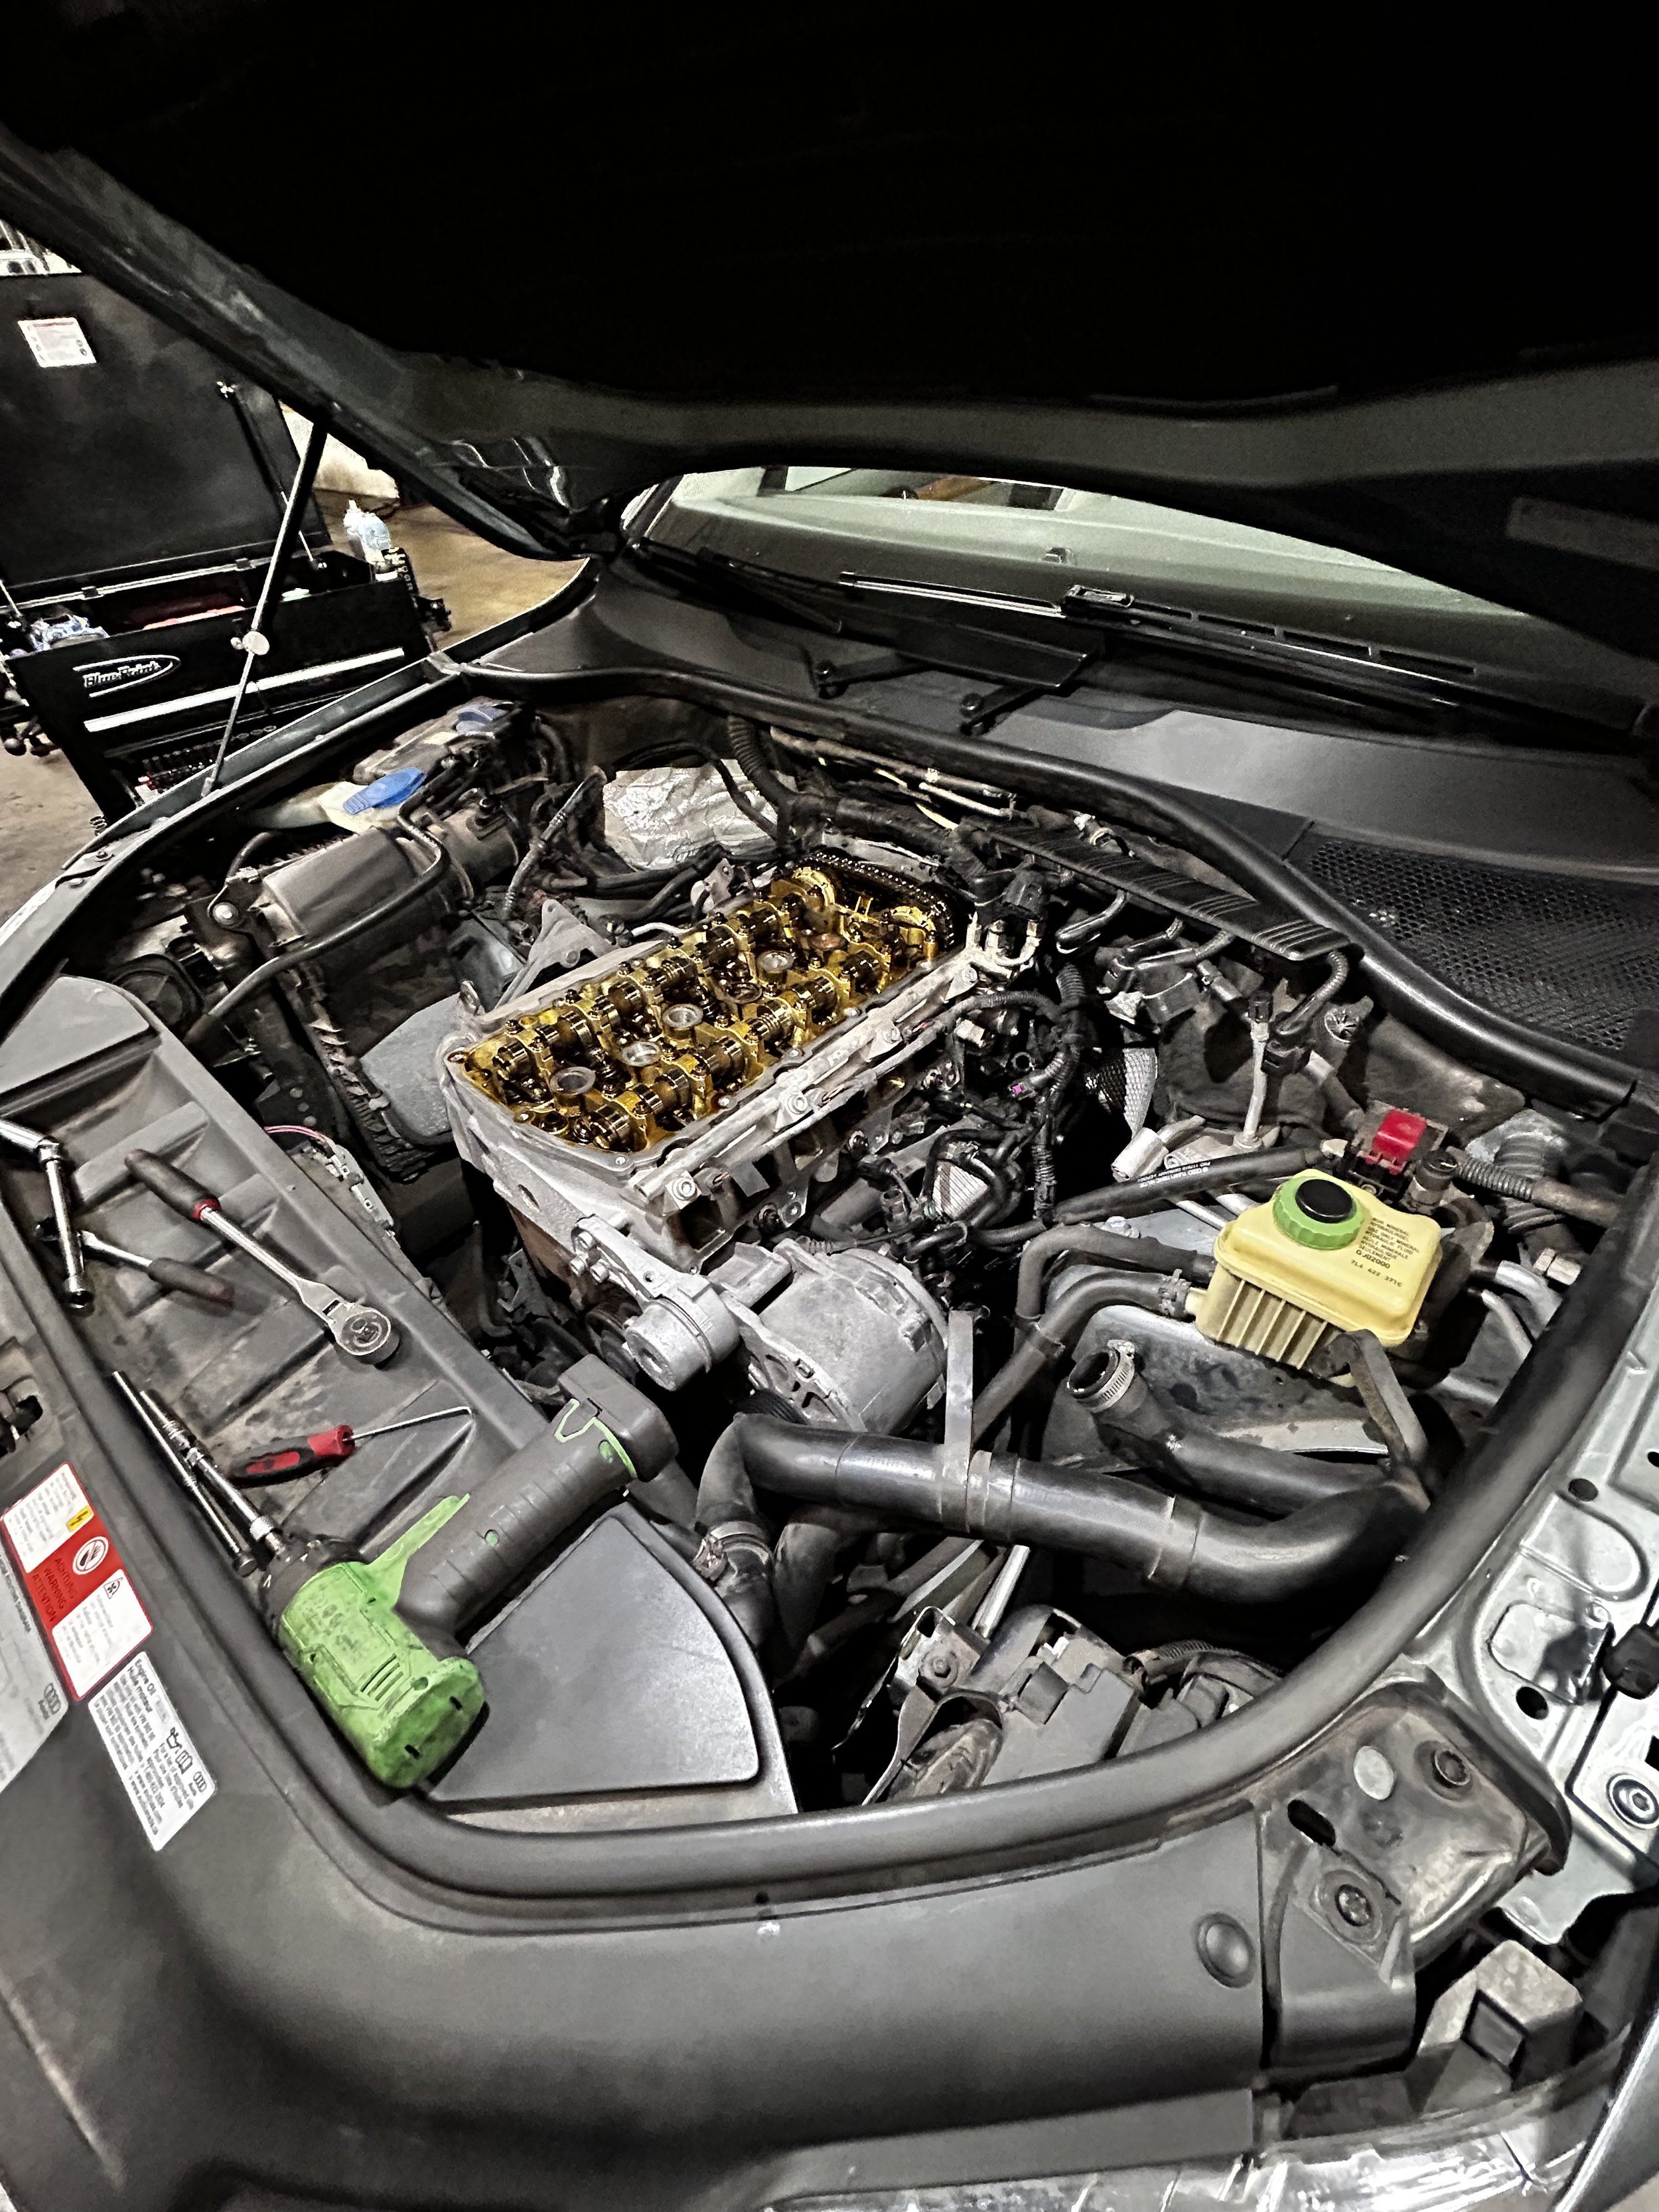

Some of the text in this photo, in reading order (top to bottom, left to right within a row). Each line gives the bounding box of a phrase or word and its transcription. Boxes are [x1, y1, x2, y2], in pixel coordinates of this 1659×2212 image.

[32, 1572, 57, 1621] ATTENTION
[43, 1566, 66, 1609] WARNING
[134, 1659, 157, 1696] Engine Oil
